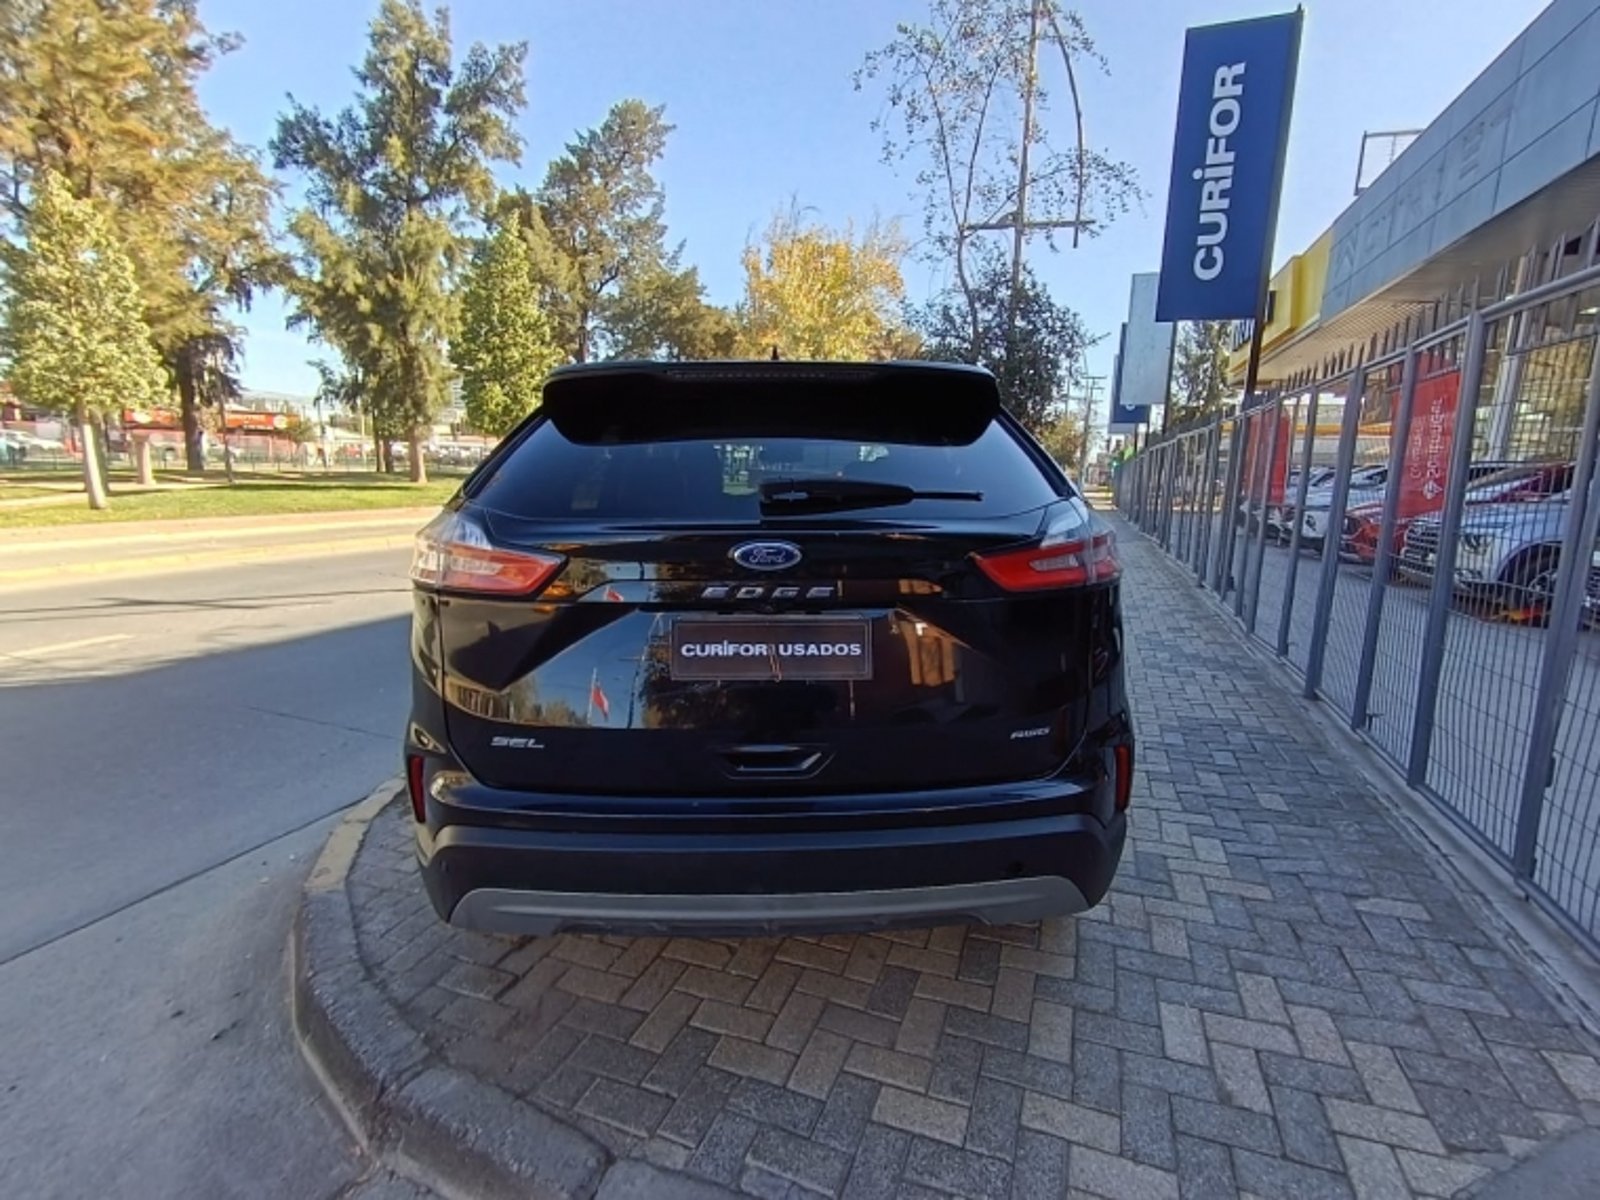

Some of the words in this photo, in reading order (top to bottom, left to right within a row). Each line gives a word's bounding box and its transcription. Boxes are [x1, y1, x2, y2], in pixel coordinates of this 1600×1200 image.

[701, 586, 835, 599] EDGE
[777, 642, 863, 657] USADOS
[490, 735, 546, 749] SEL
